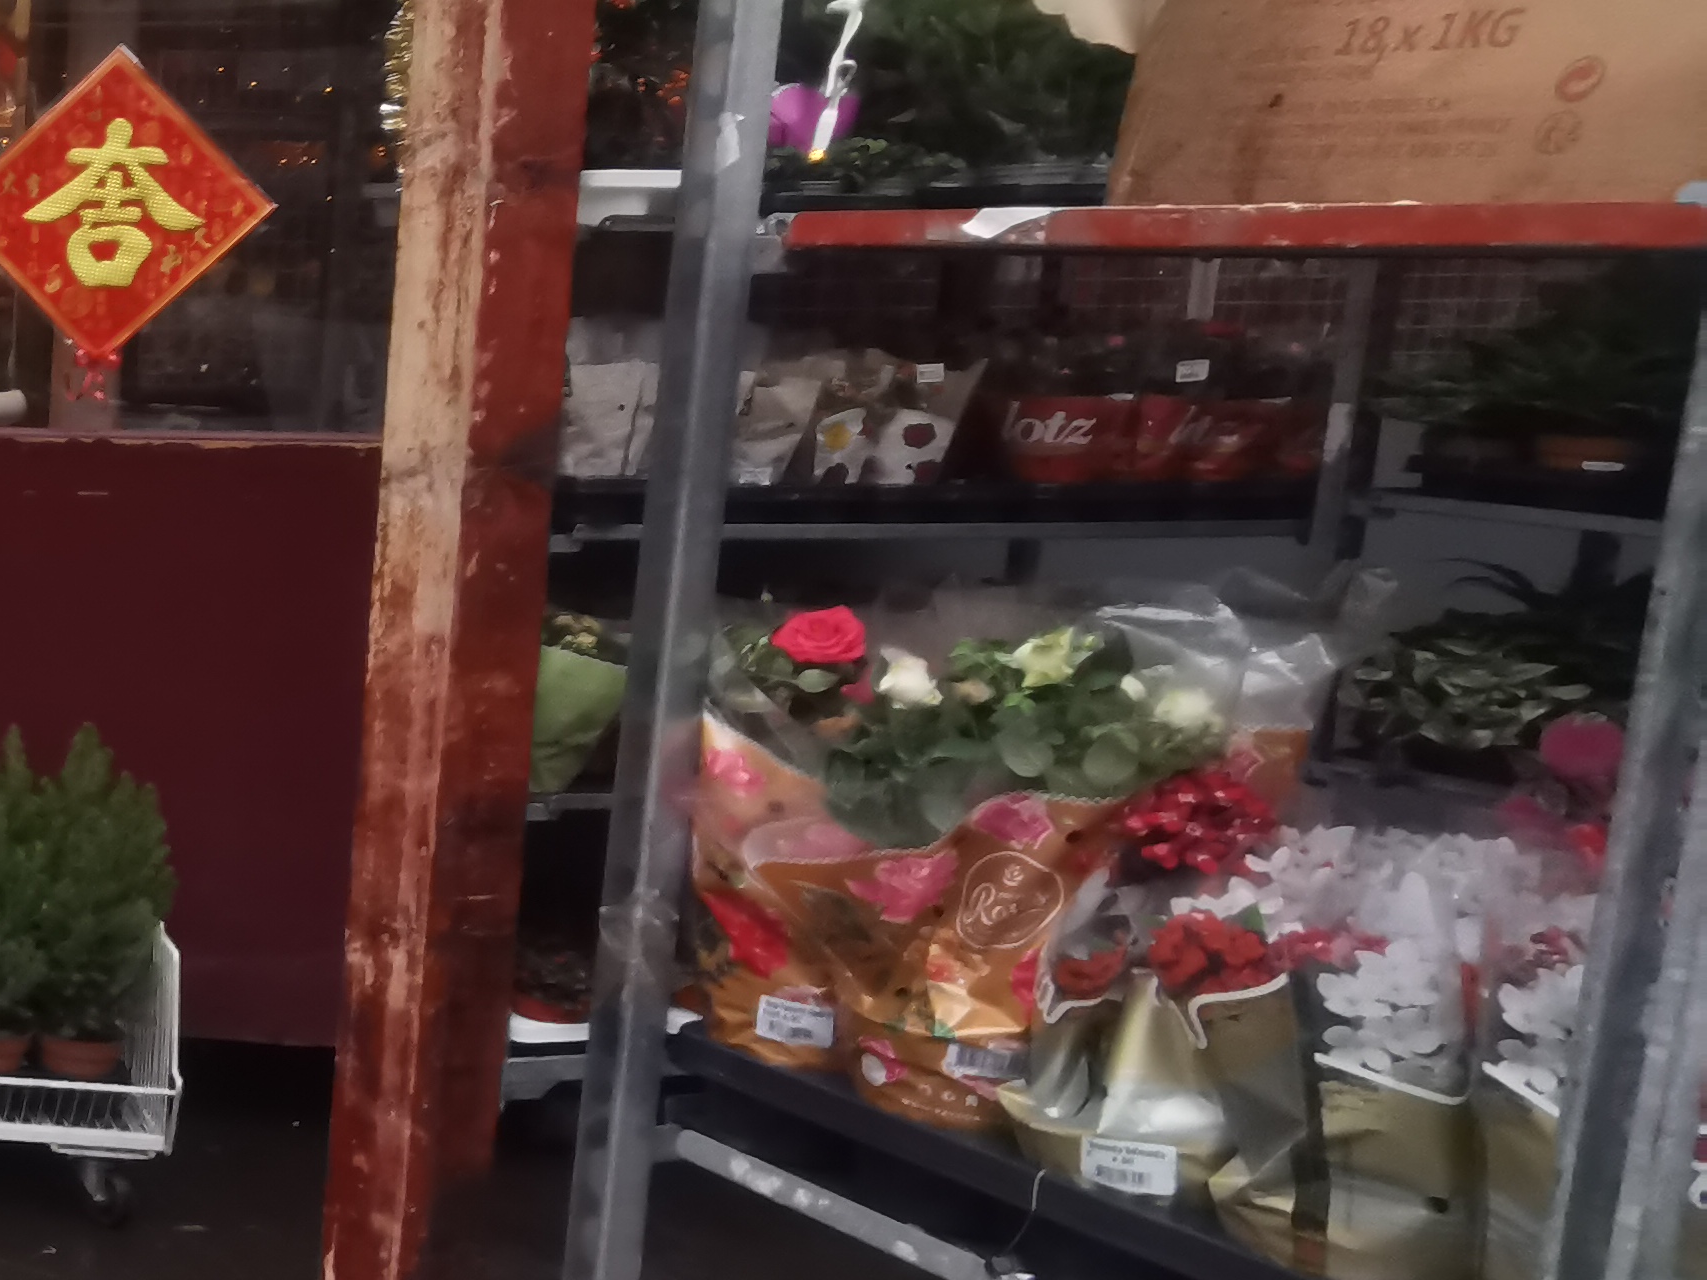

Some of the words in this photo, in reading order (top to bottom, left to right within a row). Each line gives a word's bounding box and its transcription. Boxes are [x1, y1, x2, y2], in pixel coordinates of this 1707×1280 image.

[1333, 15, 1391, 57] 18
[1392, 22, 1423, 53] x
[1428, 6, 1528, 52] 1KG
